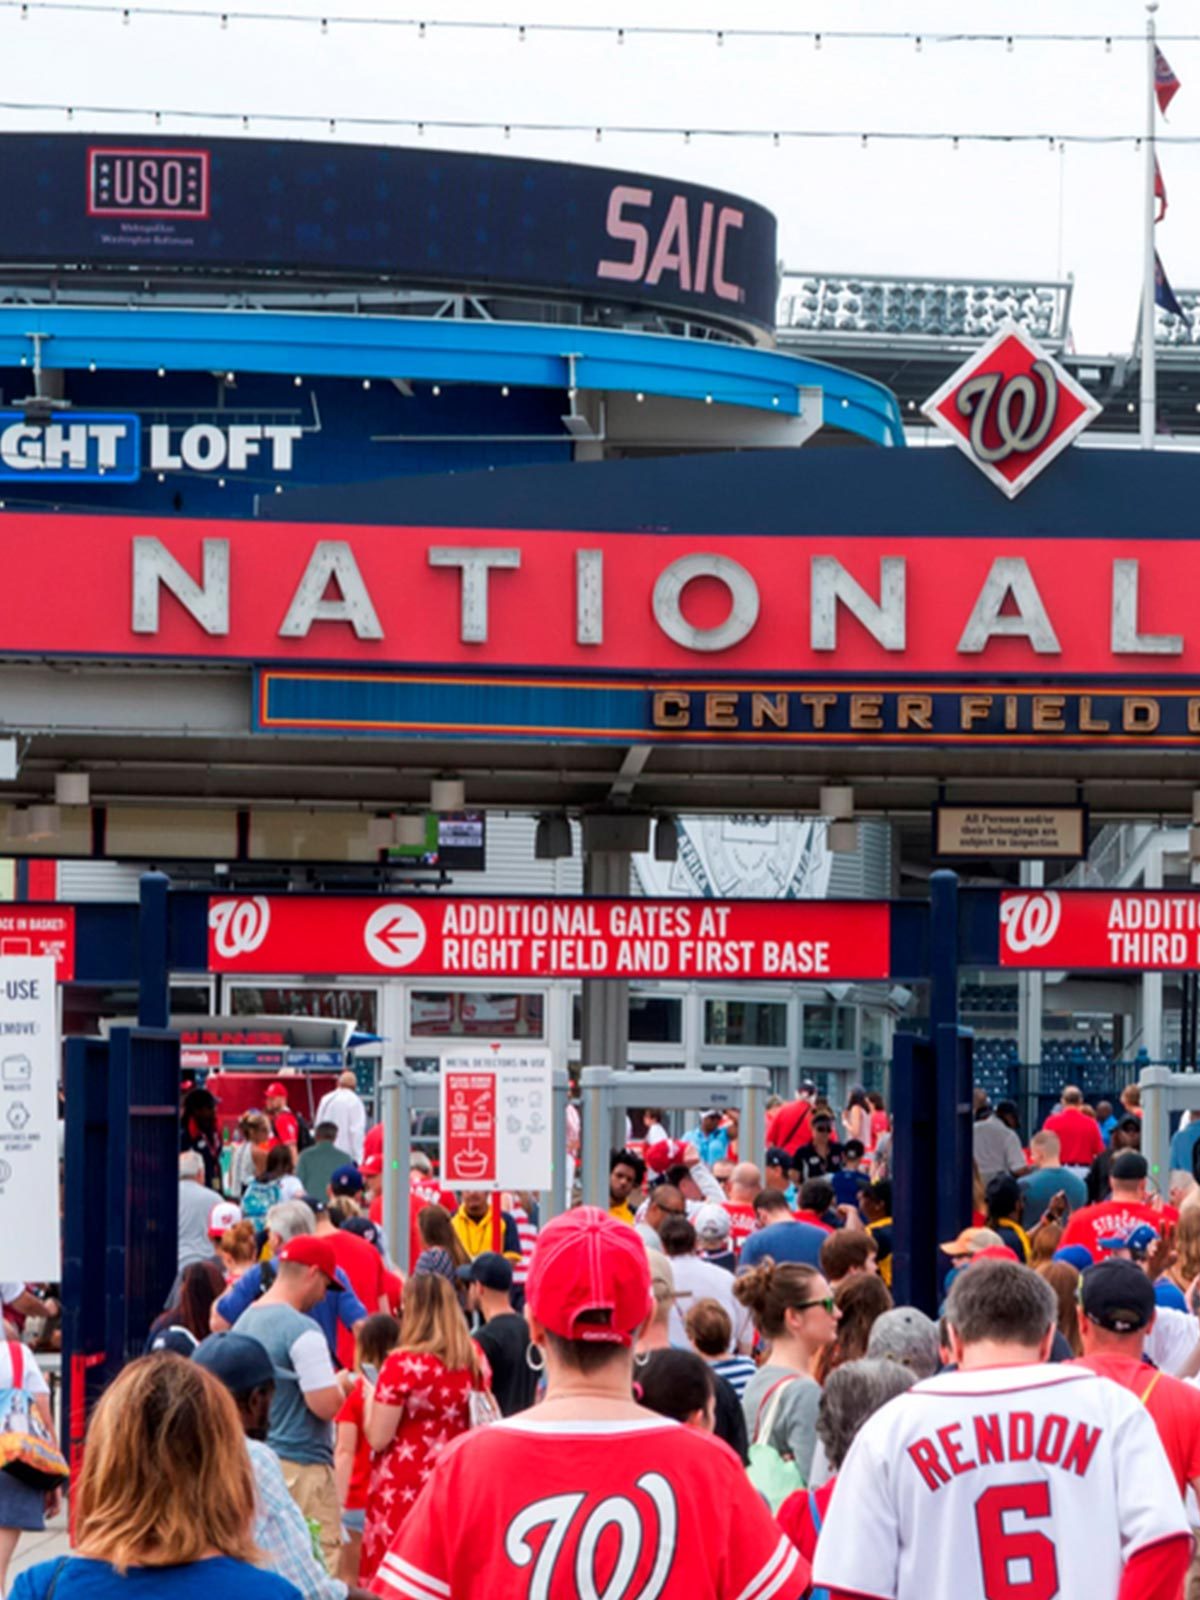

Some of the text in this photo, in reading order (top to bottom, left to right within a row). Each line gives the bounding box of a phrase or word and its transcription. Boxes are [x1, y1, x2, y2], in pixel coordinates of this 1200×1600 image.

[114, 159, 182, 206] USO
[597, 185, 744, 302] SAIC
[151, 424, 302, 470] LOFT
[653, 691, 934, 730] CENTER
[960, 695, 1161, 733] FIELD
[961, 825, 1057, 837] their belongings are
[982, 814, 1021, 824] Persons
[1023, 814, 1055, 825] and/or
[960, 837, 1059, 849] subject to inspection
[442, 904, 731, 938] ADDITIONAL GATES AT
[442, 938, 830, 973] RIGHT FIELD AND FIRST BASE
[1107, 933, 1188, 964] THIRD
[907, 1411, 1103, 1492] RENDON
[974, 1480, 1060, 1600] 6
